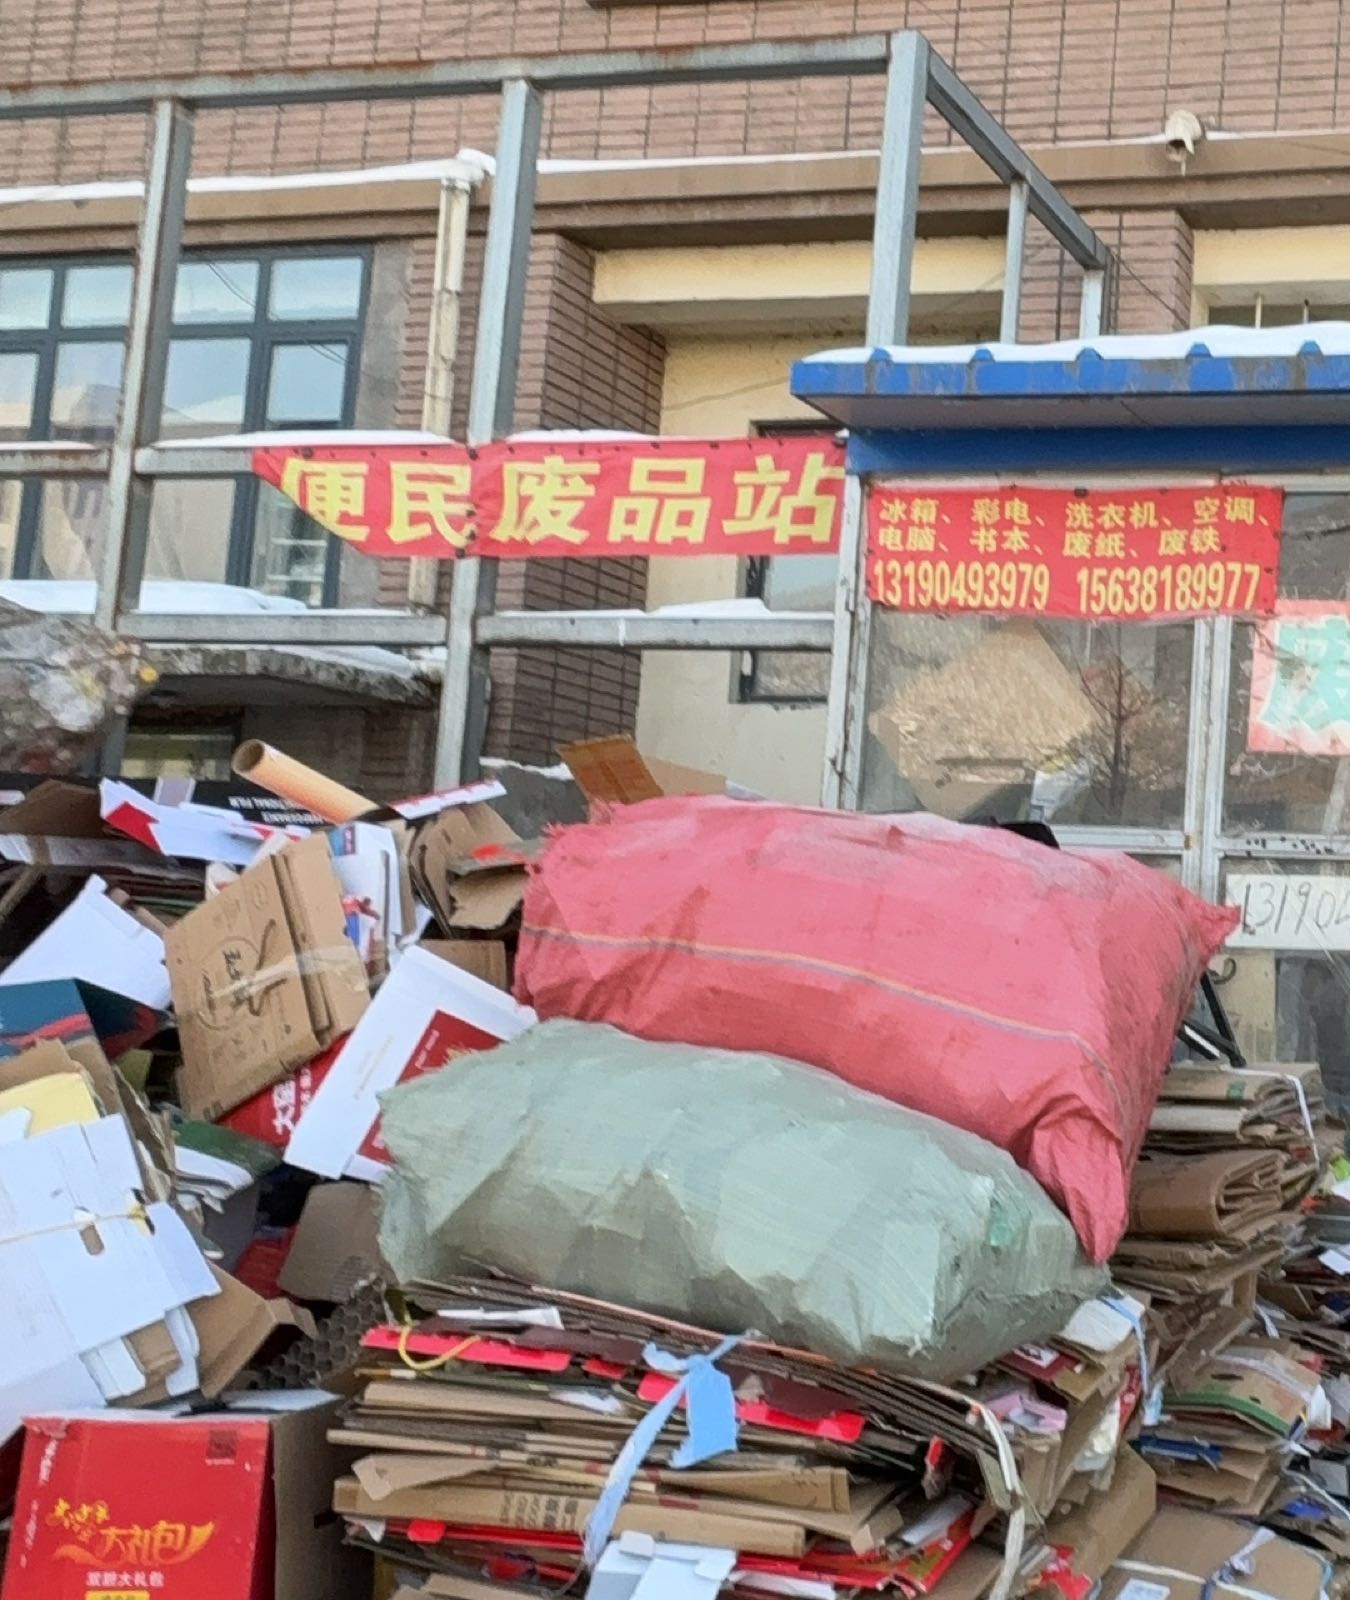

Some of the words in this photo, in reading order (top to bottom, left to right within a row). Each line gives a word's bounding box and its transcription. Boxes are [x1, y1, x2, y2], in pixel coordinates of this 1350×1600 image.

[280, 451, 846, 546] 便民废品站
[873, 559, 1050, 610] 13190493979
[1077, 561, 1260, 614] 15638189977
